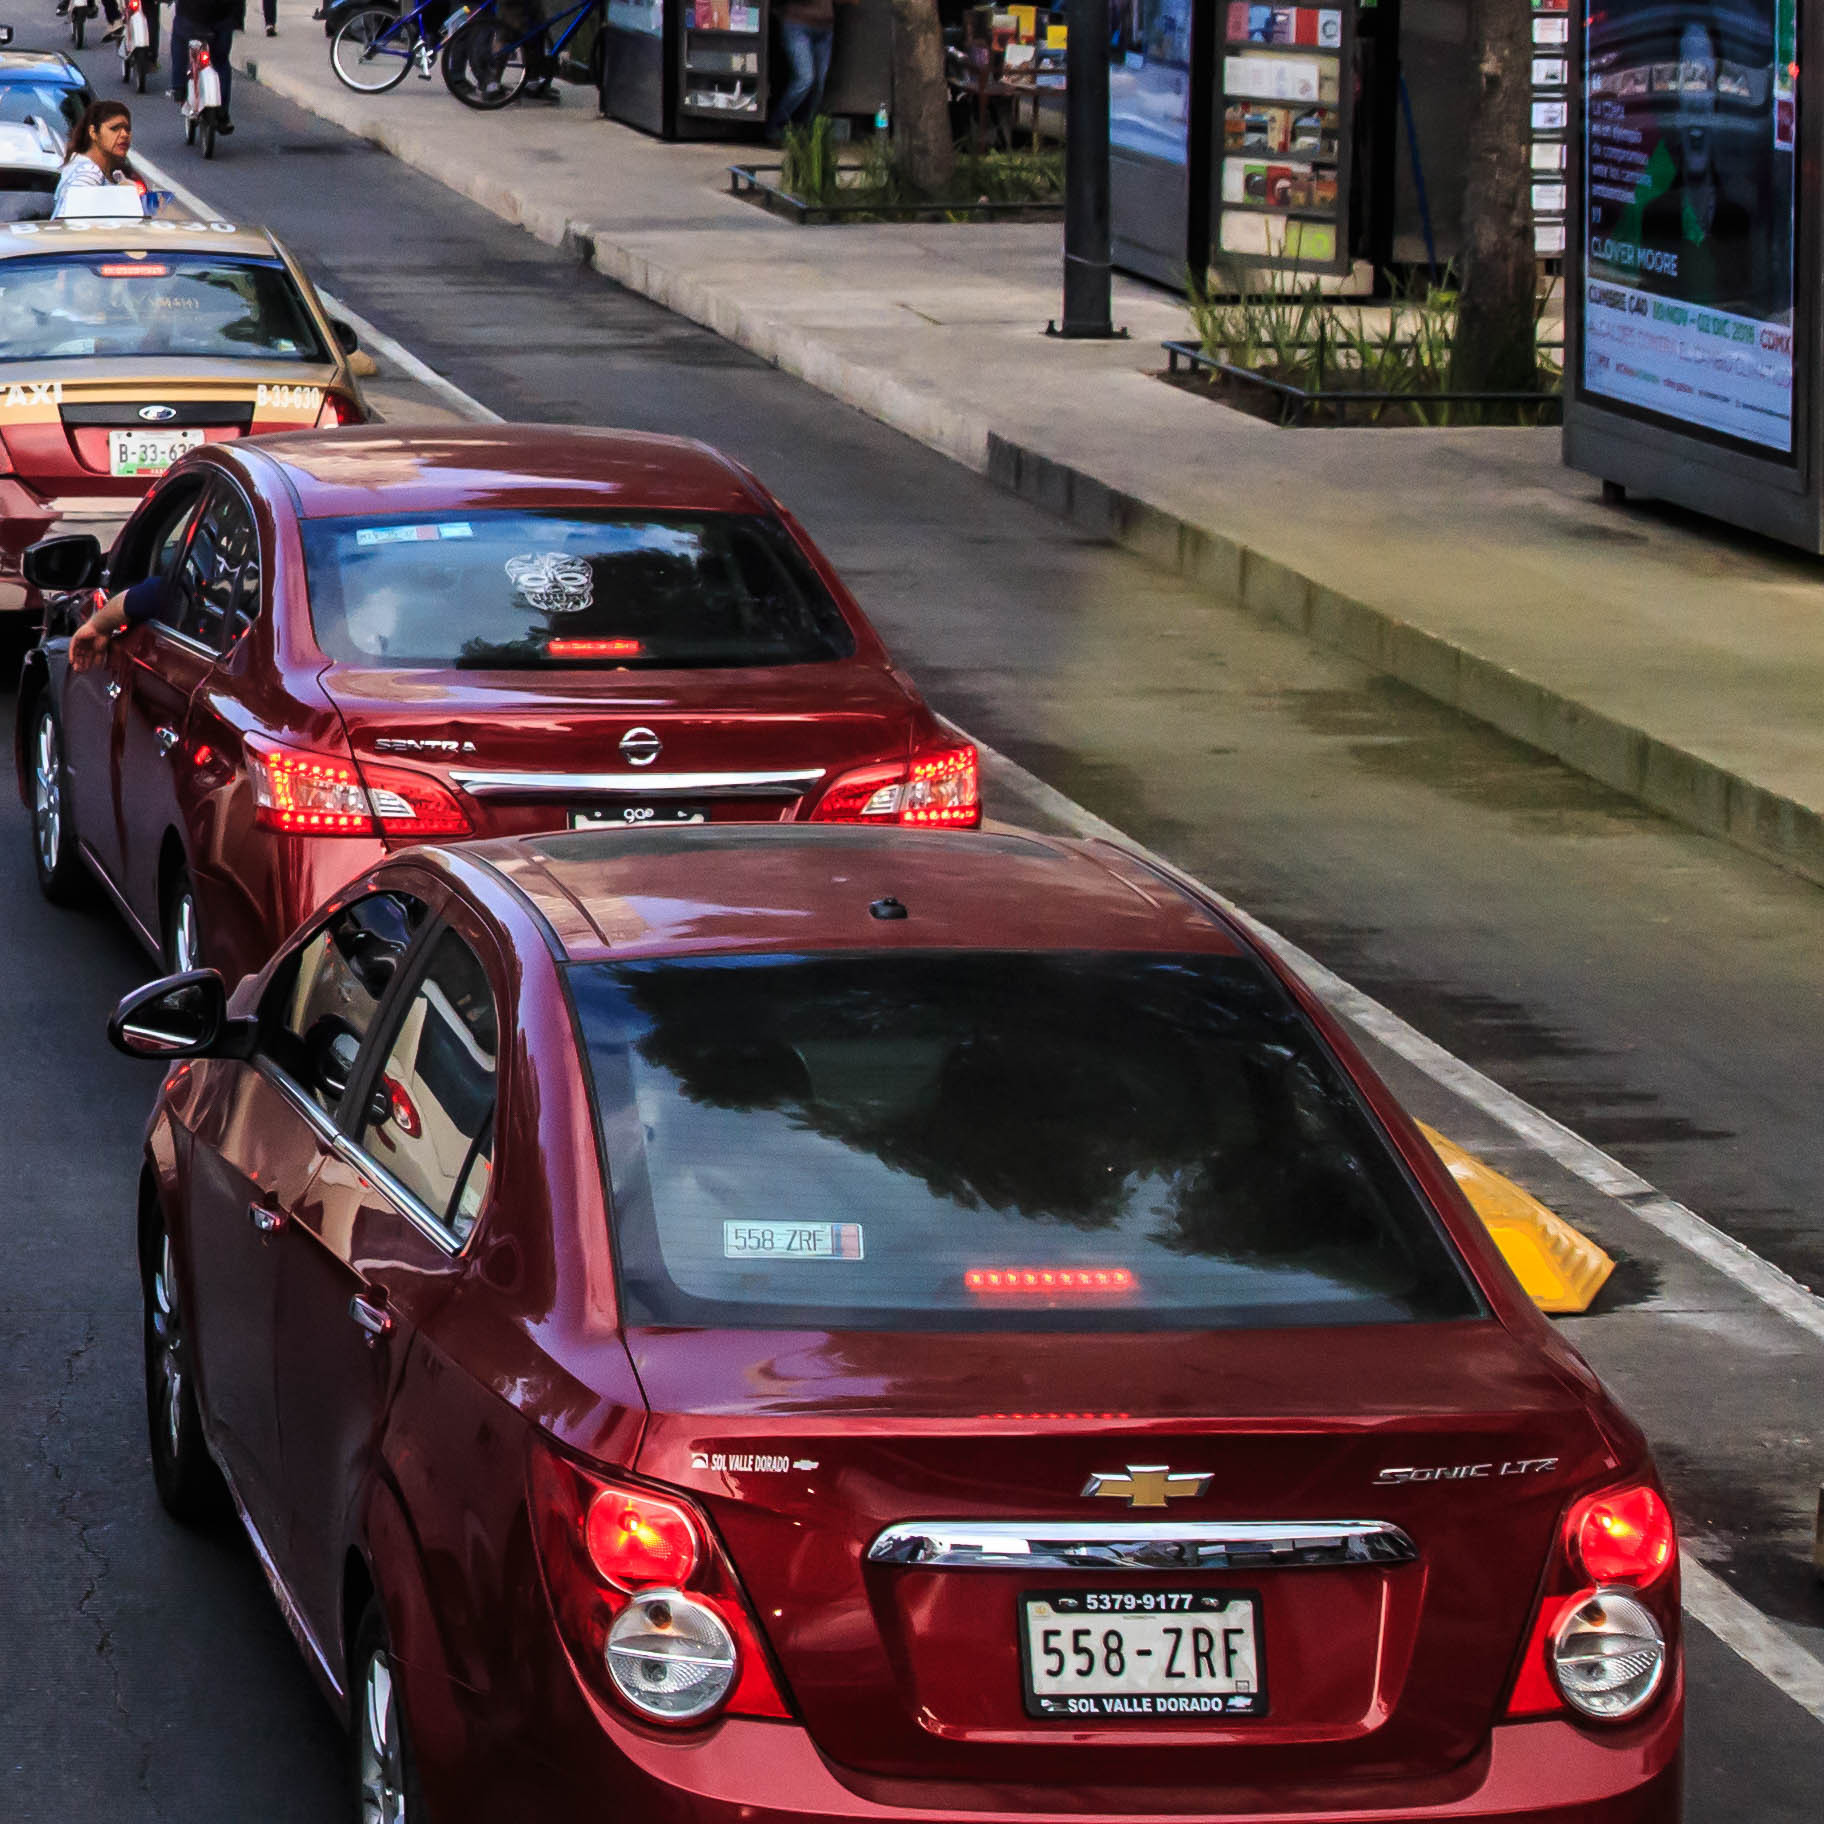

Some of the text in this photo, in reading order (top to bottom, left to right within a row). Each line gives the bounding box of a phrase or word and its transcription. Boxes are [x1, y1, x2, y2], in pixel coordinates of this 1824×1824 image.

[256, 384, 320, 409] B-33-630
[374, 738, 477, 753] SENTRA
[735, 1229, 825, 1252] 558 ZRF
[711, 1453, 789, 1473] SOL VALLE DORADO
[1500, 1458, 1559, 1475] LTZ
[1086, 1593, 1193, 1610] 5379-9177
[1042, 1627, 1245, 1679] 558-ZRF
[1067, 1697, 1223, 1713] SOL VALLE DORADO
